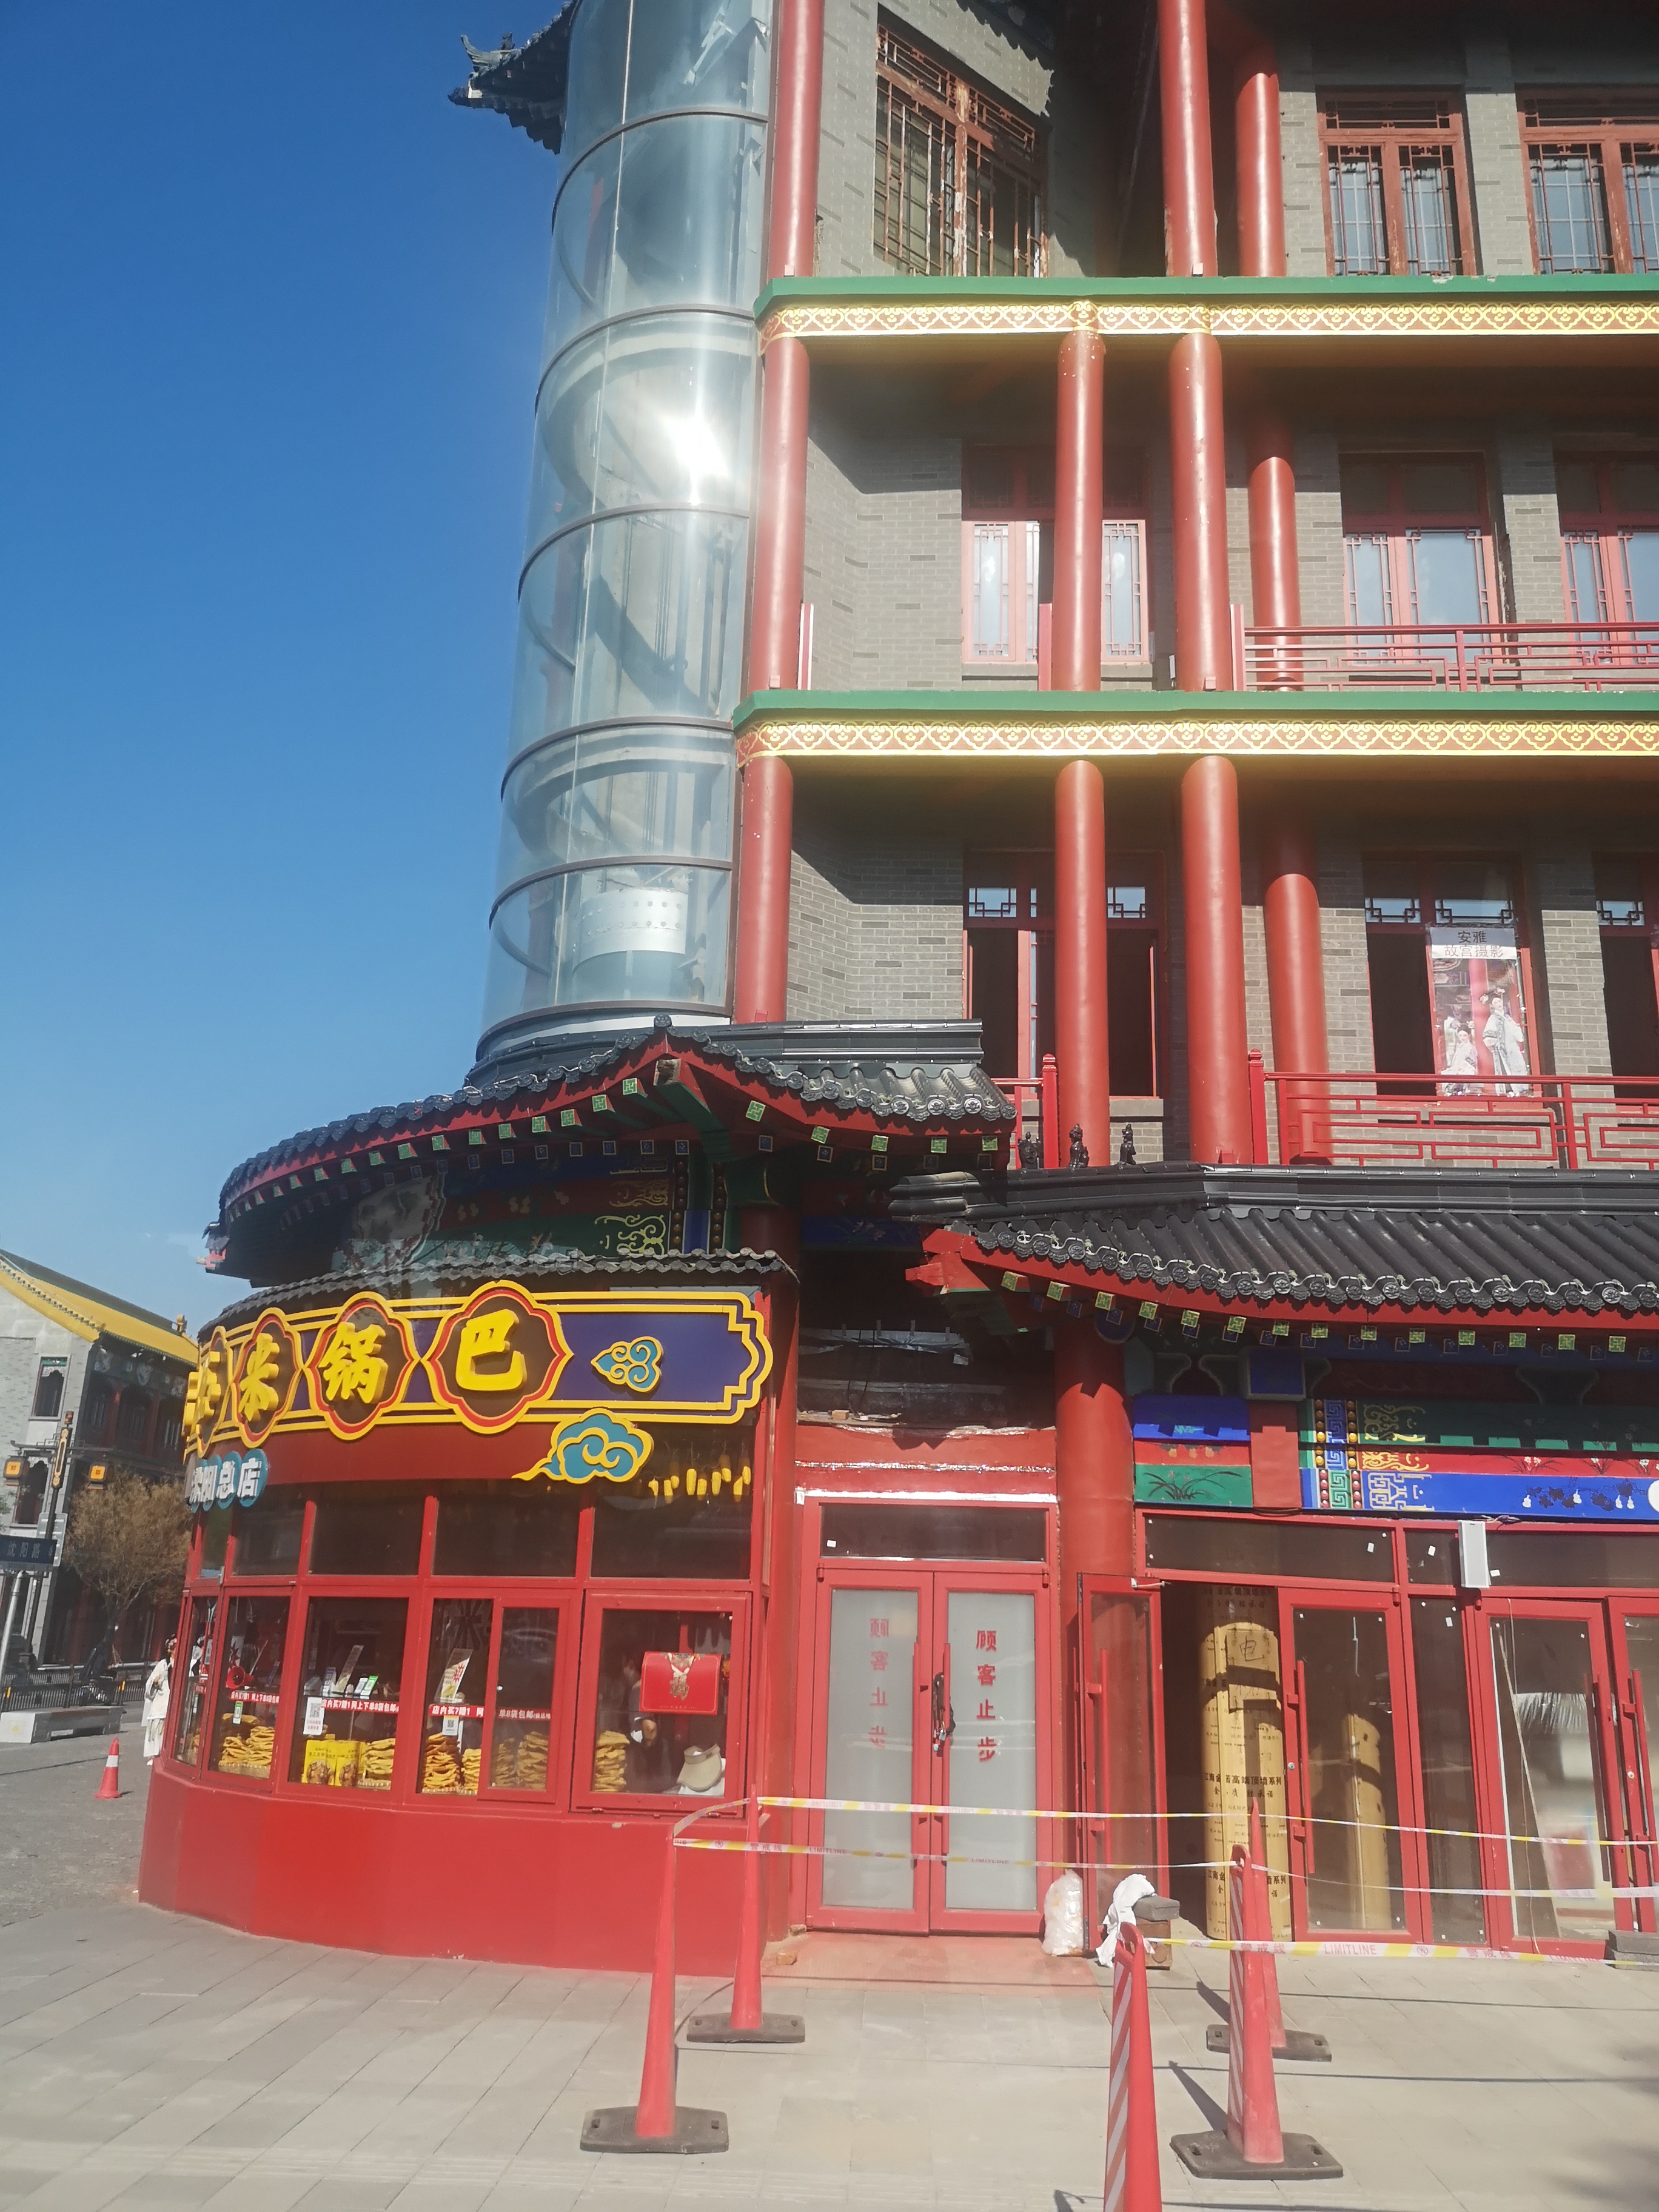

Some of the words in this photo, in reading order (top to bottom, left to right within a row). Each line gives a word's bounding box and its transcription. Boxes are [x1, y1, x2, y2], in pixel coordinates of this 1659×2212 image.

[1458, 930, 1487, 943] 安雅
[1444, 945, 1504, 958] 故宫摄影
[189, 1457, 263, 1504] 沈阳总店
[976, 1630, 997, 1762] 顾客止步
[809, 1846, 846, 1855] LIMITLINE
[1241, 1943, 1286, 1954] 警戒线
[1324, 1943, 1377, 1955] LIMITLINE
